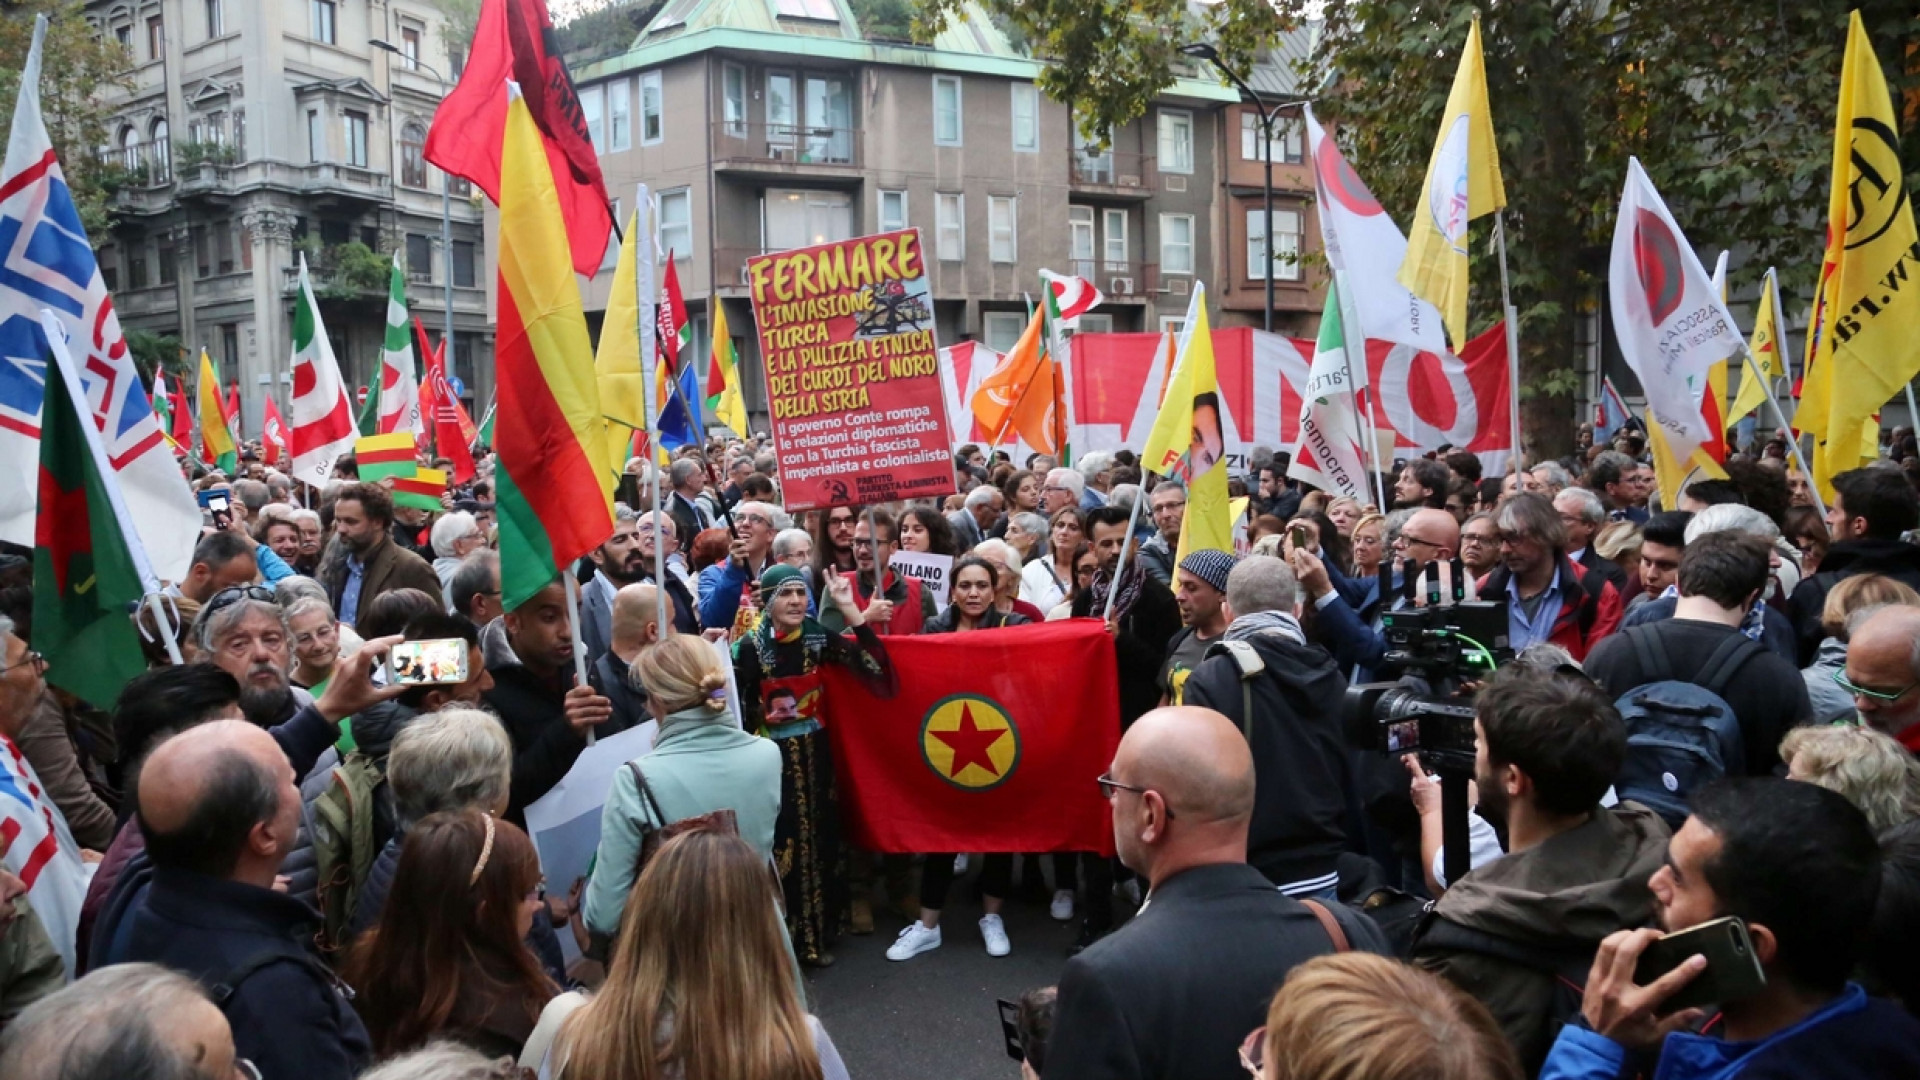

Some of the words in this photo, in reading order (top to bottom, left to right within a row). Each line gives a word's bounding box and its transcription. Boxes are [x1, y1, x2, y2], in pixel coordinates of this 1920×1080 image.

[750, 233, 921, 304] FERMARE
[759, 289, 876, 328] L'INVASIONE
[762, 322, 830, 350] TURCA
[766, 352, 777, 375] E
[779, 350, 798, 372] LA
[800, 340, 868, 369] PULIZIA
[871, 330, 933, 359] ETNICA
[769, 374, 798, 397] DEI
[801, 368, 854, 393] CURDI
[857, 362, 887, 385] DEL
[890, 353, 937, 378] NORD
[773, 395, 819, 420] DELLA
[821, 386, 871, 412] SIRIA
[777, 423, 787, 436] Il
[788, 417, 842, 437] governo
[844, 410, 884, 426] Conte
[886, 405, 930, 422] rompa
[780, 437, 792, 450] le
[794, 431, 848, 449] relazioni
[852, 419, 938, 442] diplomatiche
[782, 453, 805, 465] con
[807, 449, 819, 462] la
[821, 444, 867, 460] Turchia
[869, 437, 920, 456] fascista
[784, 461, 860, 481] imperialista
[862, 459, 871, 470] e
[874, 449, 950, 469] colonialista
[855, 474, 893, 485] PARTITO
[857, 475, 949, 494] MARXISTA-LENINISTA
